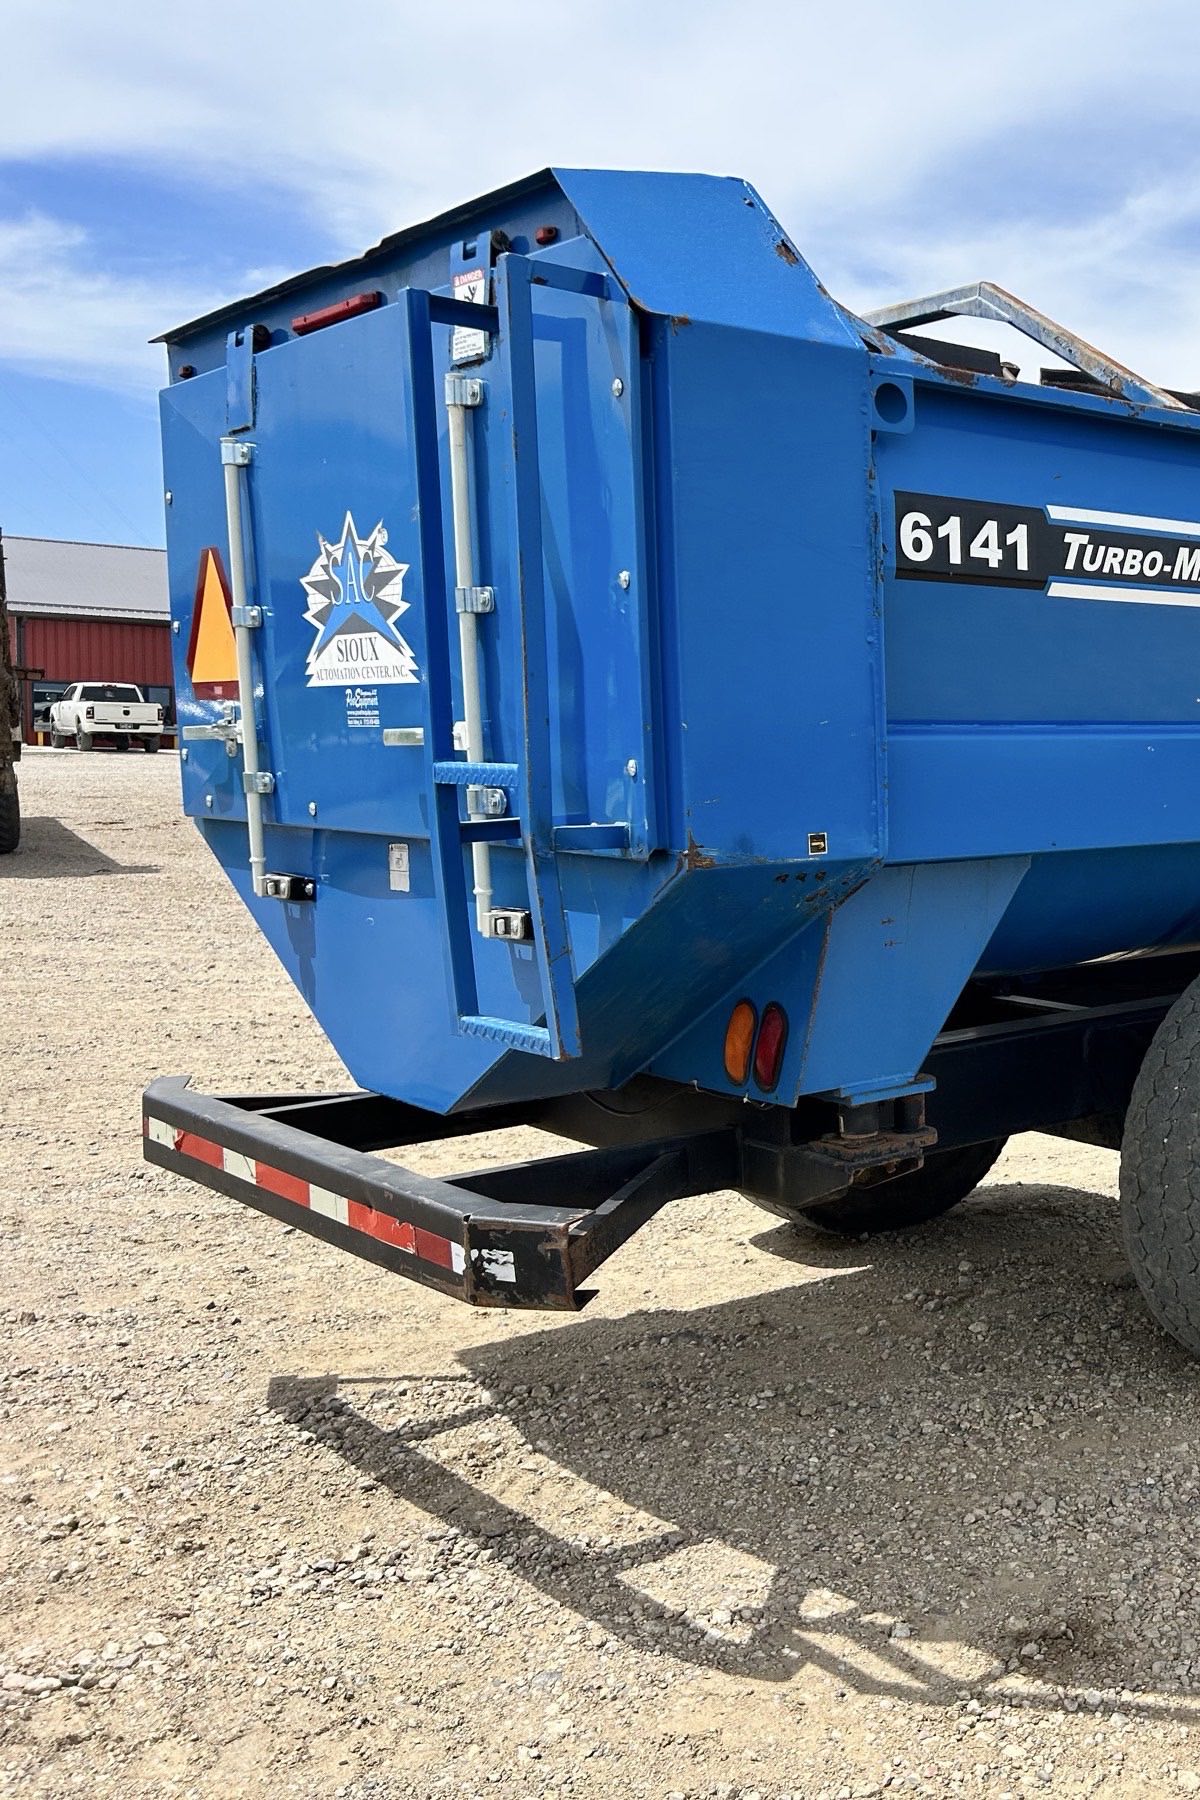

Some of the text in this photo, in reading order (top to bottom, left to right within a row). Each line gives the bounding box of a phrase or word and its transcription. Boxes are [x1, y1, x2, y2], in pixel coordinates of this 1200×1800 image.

[900, 511, 1029, 572] 6141
[329, 551, 375, 605] SAC
[336, 636, 379, 663] SIOUX
[316, 664, 408, 681] AUTOMATION CENTER, INC.
